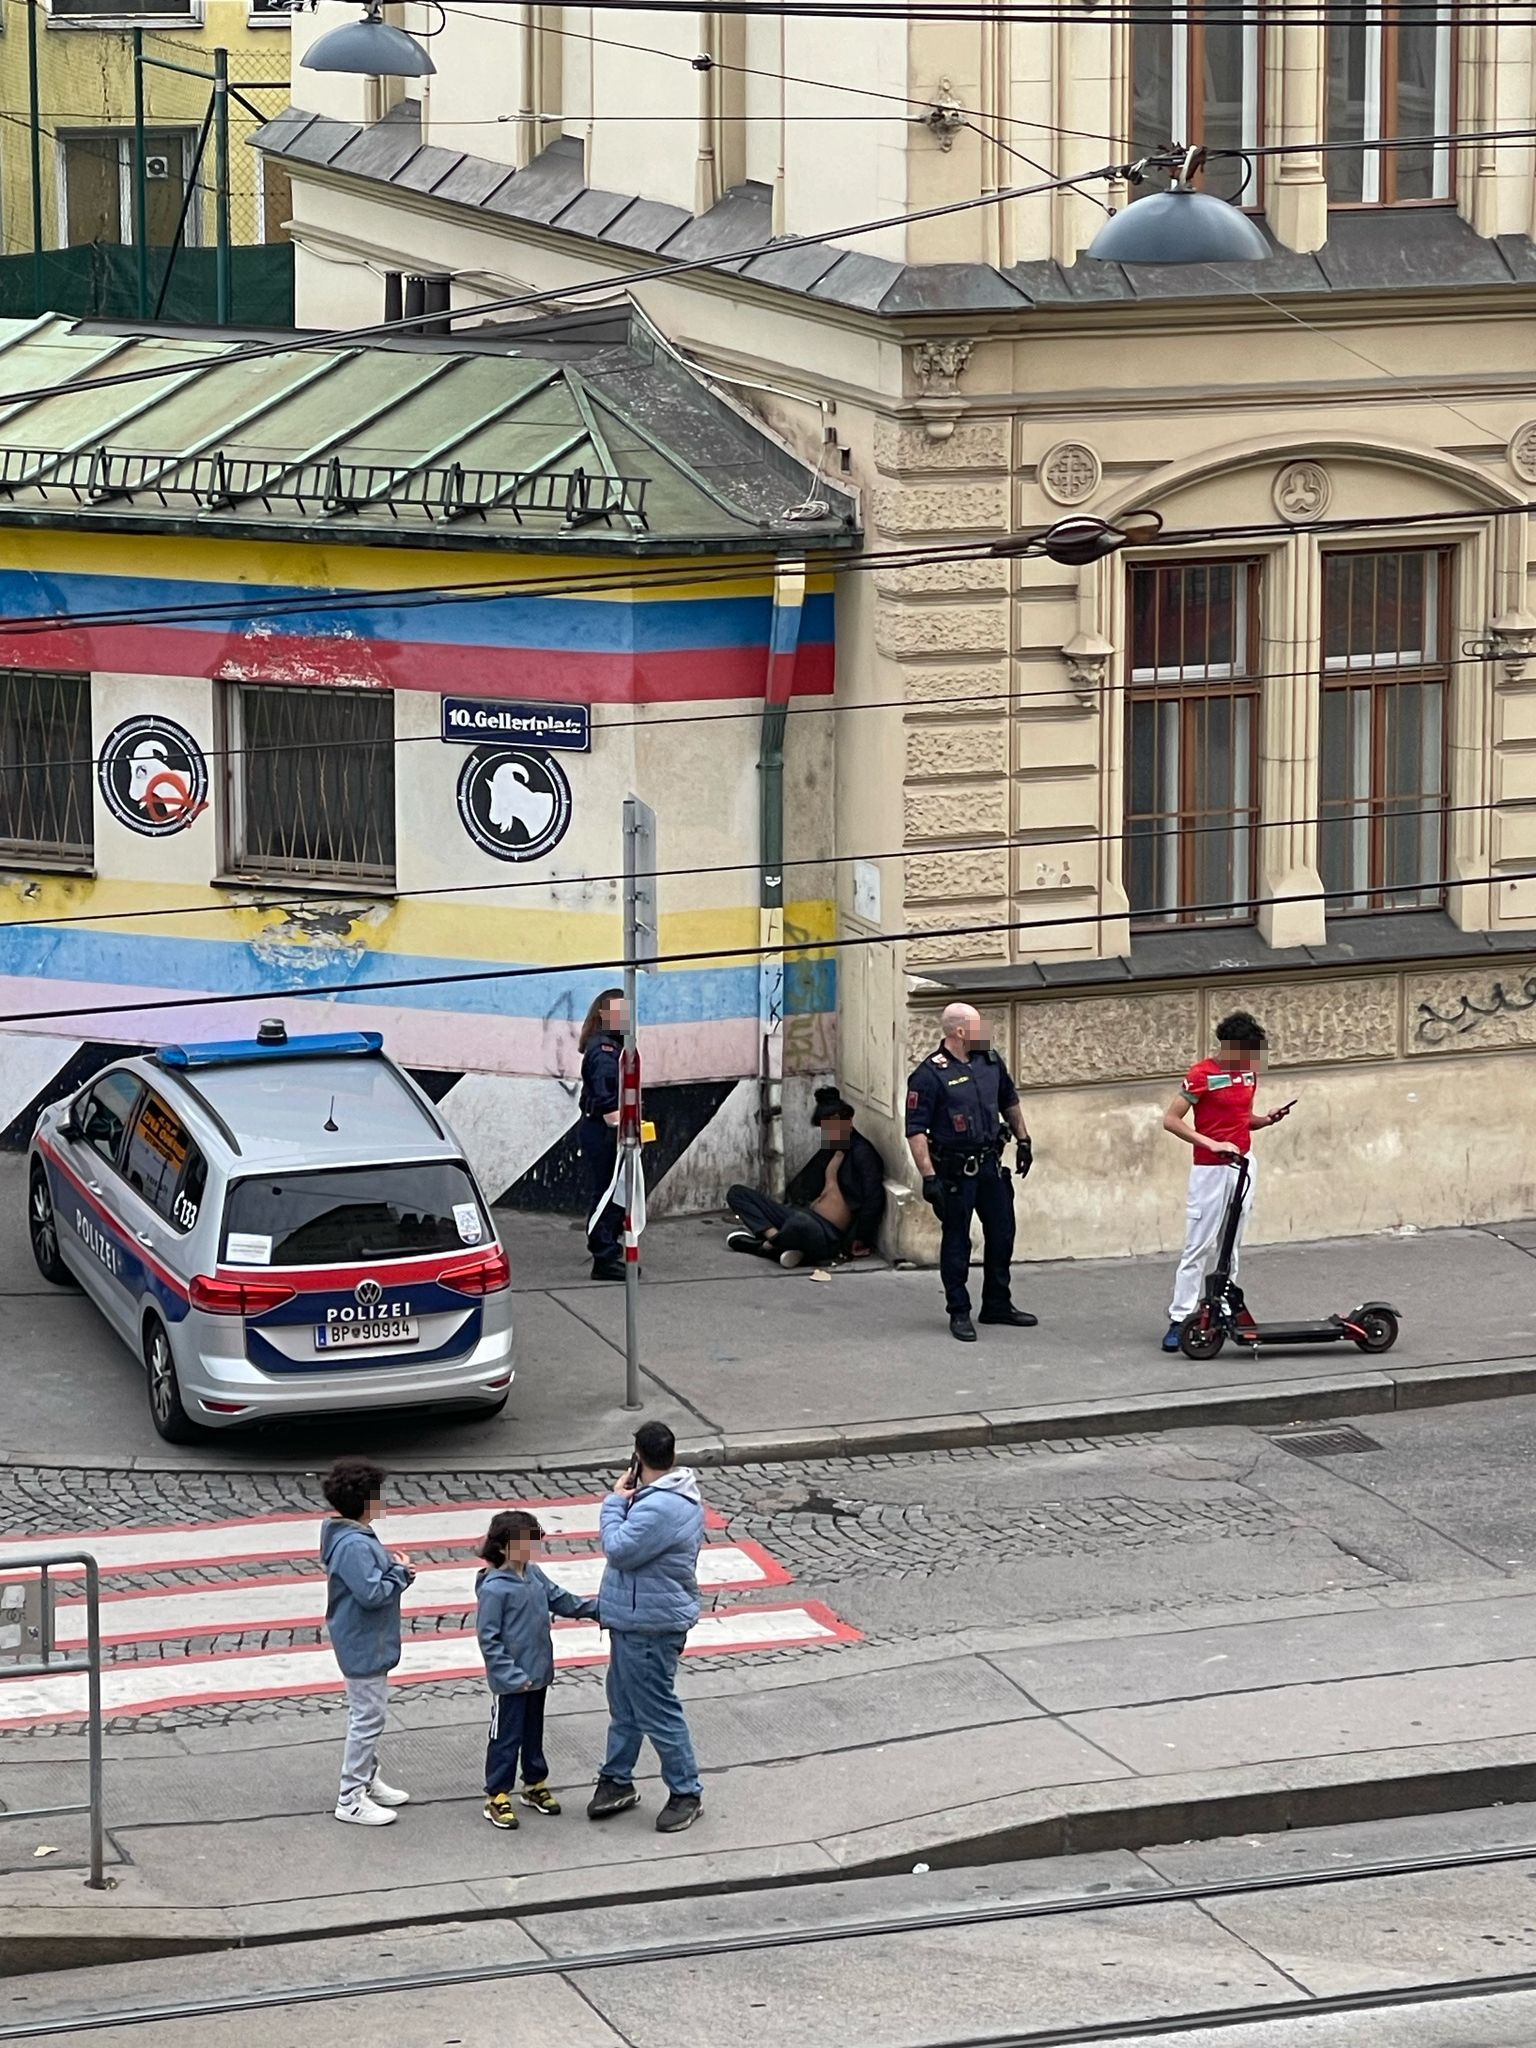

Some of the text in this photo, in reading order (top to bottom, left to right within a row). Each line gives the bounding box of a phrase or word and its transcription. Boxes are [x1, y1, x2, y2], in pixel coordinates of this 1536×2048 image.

[179, 1198, 198, 1230] 133
[76, 1208, 117, 1275] POLIZEI
[327, 1302, 410, 1322] POLIZEI
[331, 1320, 410, 1342] BP 90934
